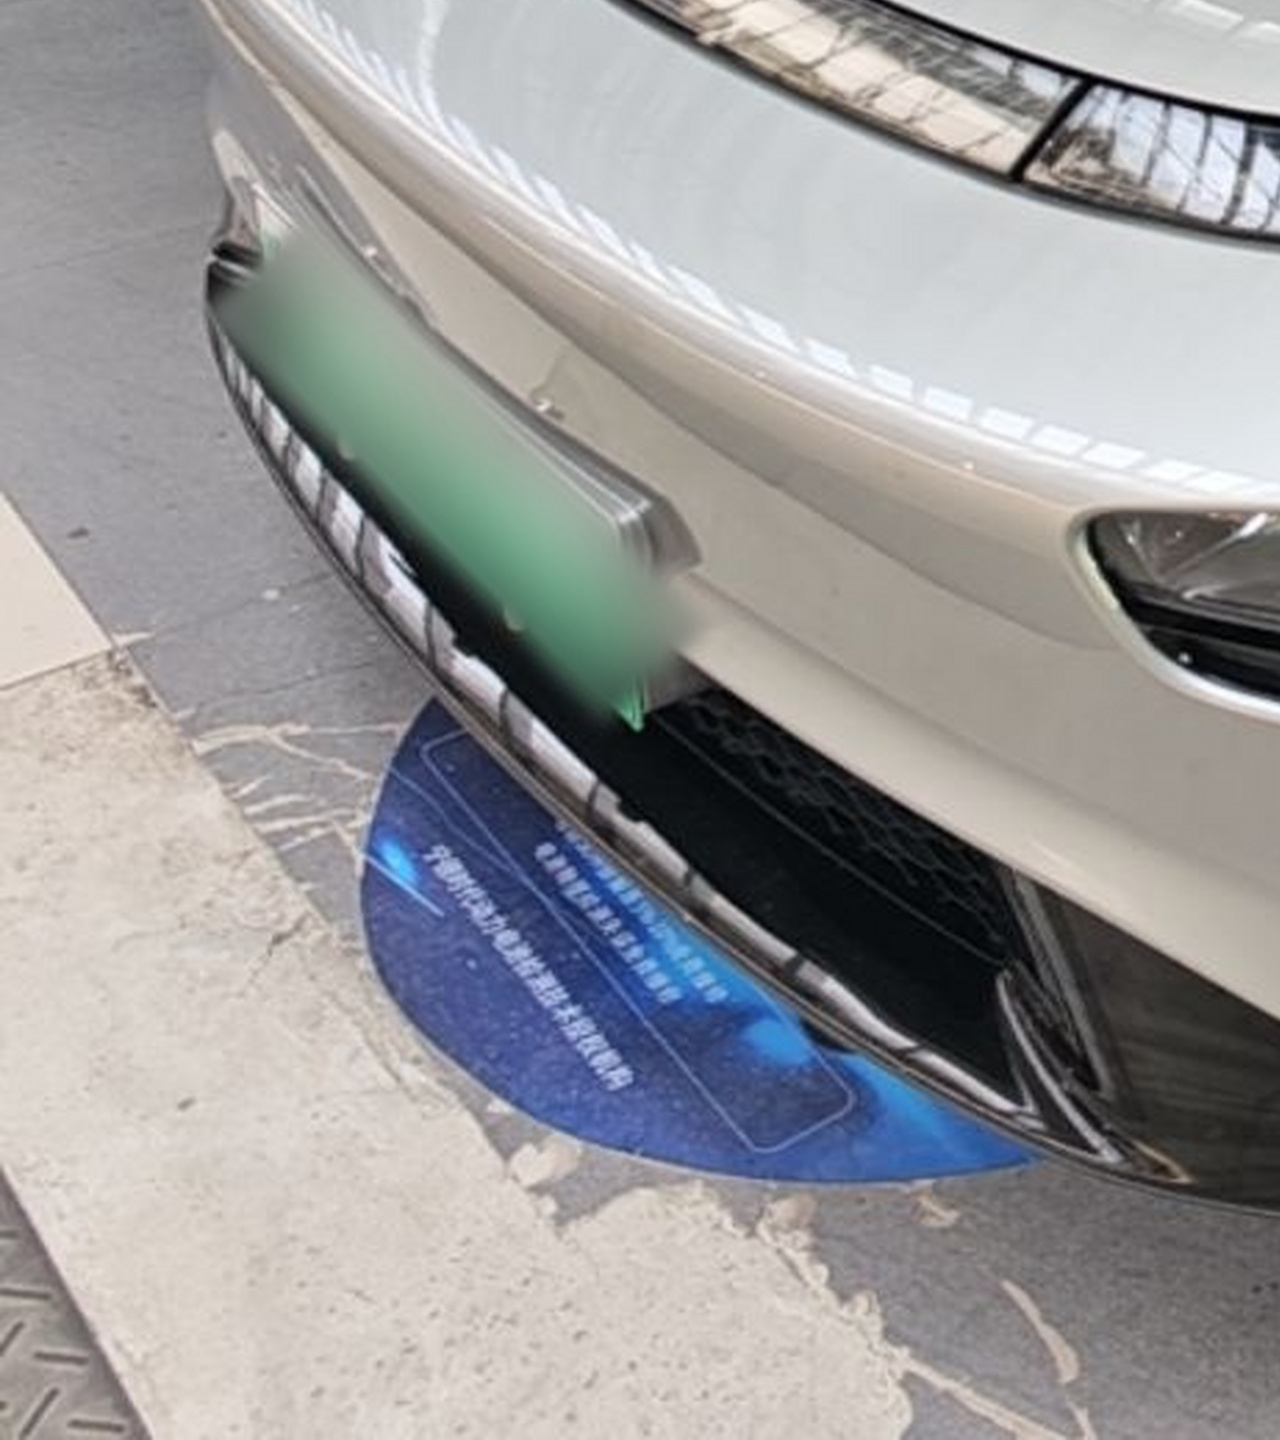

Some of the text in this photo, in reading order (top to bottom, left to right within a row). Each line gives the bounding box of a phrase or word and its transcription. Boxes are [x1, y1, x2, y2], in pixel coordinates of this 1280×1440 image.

[424, 844, 635, 1091] 宁德时代动力电池检测技术授权机构
